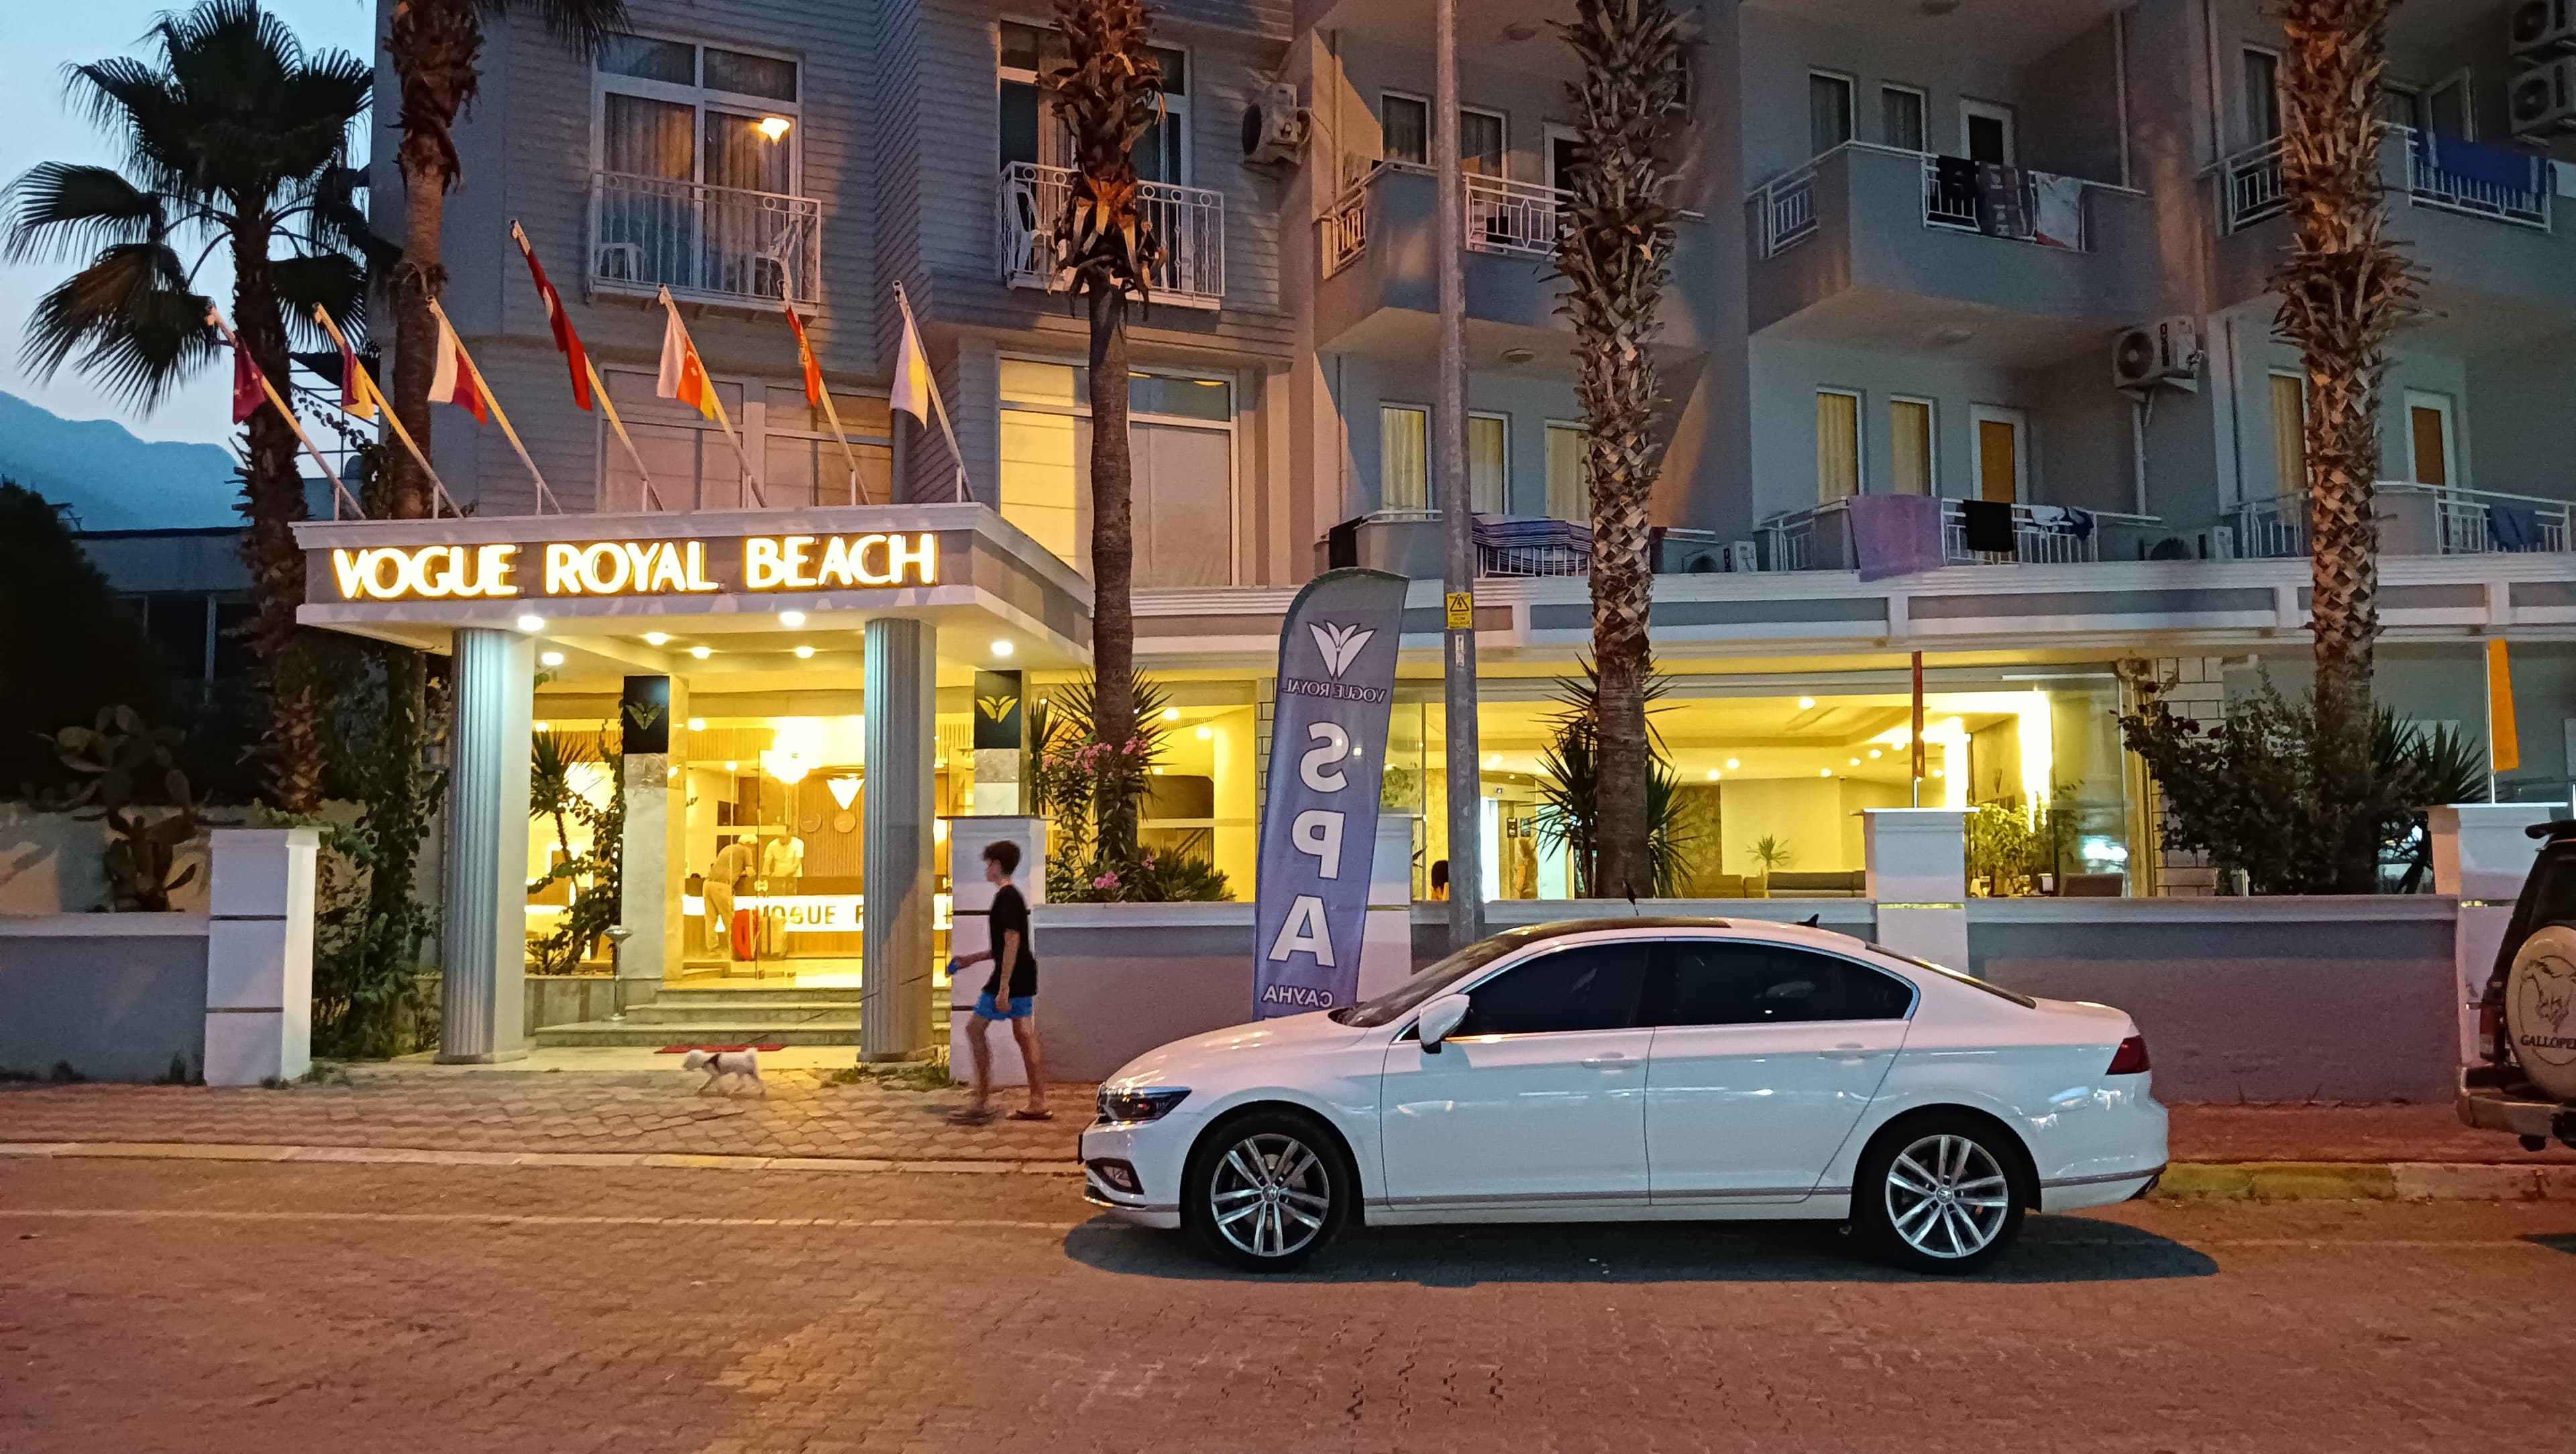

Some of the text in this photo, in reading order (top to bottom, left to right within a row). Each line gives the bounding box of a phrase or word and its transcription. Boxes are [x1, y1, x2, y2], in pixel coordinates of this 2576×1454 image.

[333, 533, 935, 599] VOGUE ROYAL BEACH
[2520, 1034, 2576, 1050] GALLOPE
